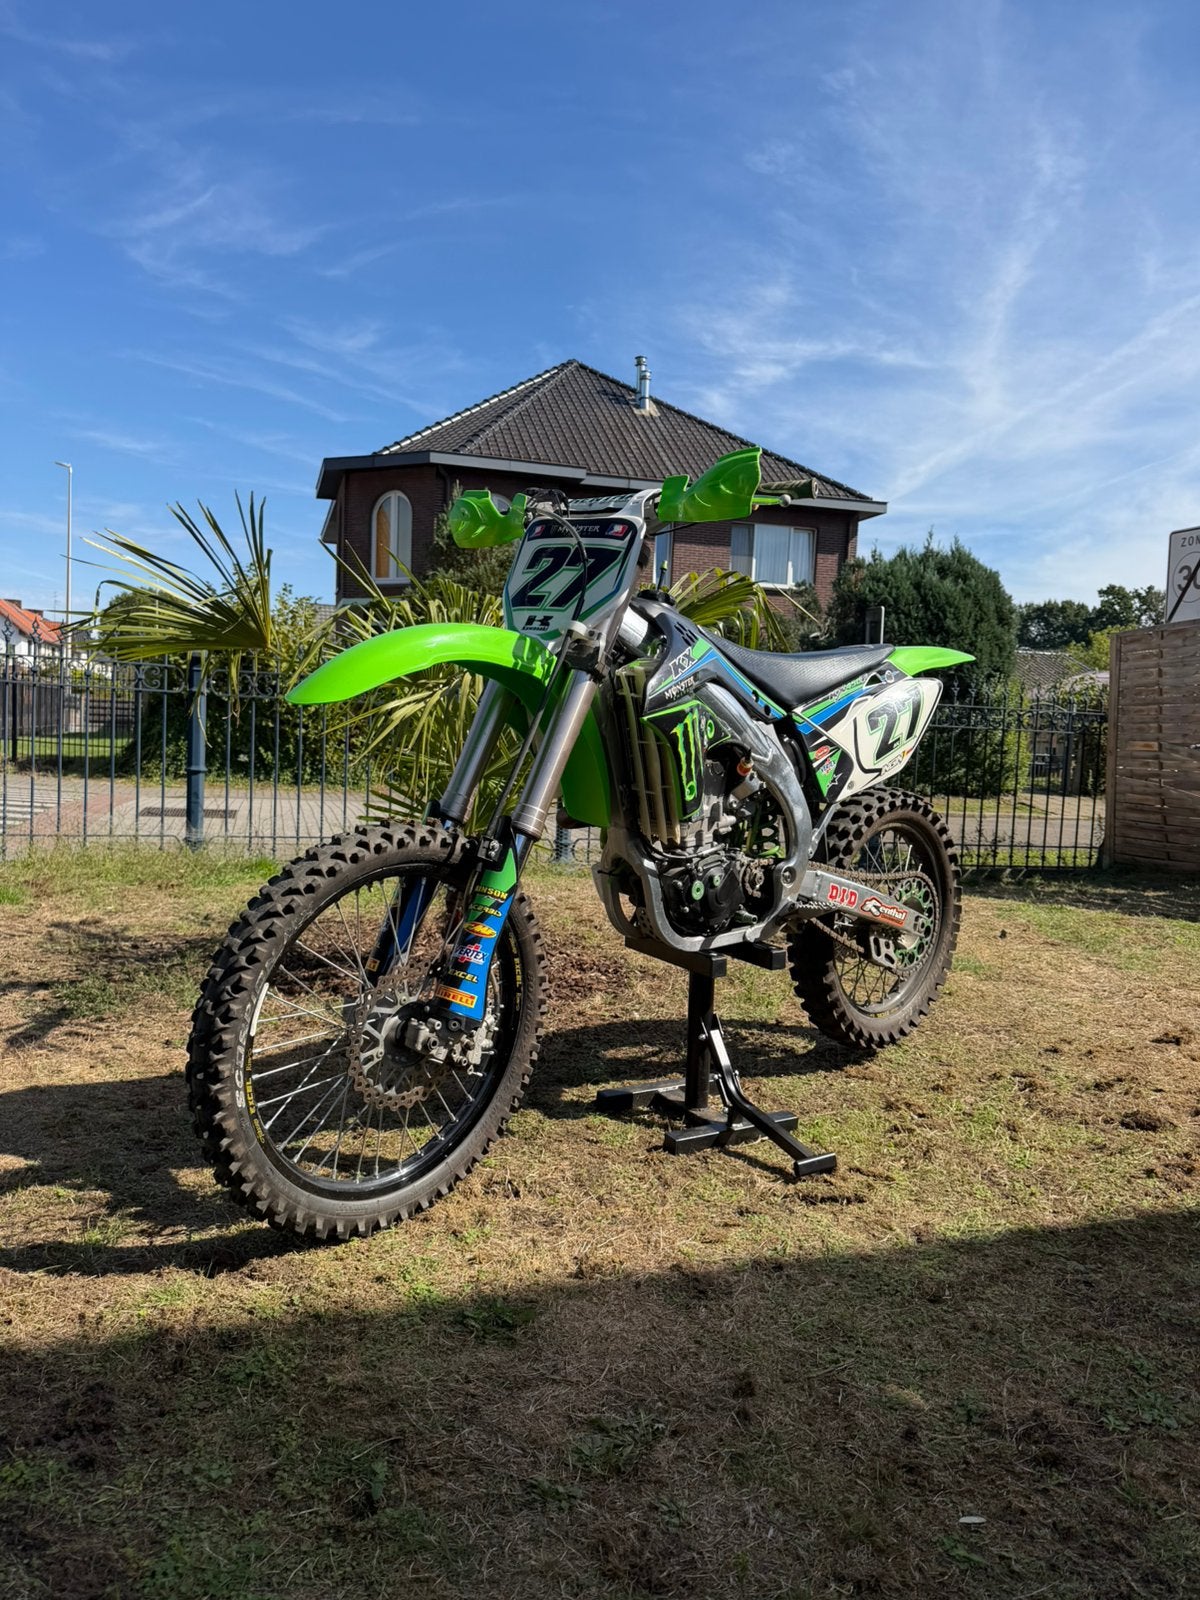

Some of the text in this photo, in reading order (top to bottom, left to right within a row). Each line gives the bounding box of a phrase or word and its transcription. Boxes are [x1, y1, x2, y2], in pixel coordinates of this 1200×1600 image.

[511, 545, 624, 610] 27
[669, 647, 698, 680] KX
[664, 676, 695, 700] MONSTER
[866, 683, 924, 765] 27
[828, 882, 858, 909] DID
[448, 968, 479, 983] EXCEL
[245, 1077, 256, 1115] EXCEL
